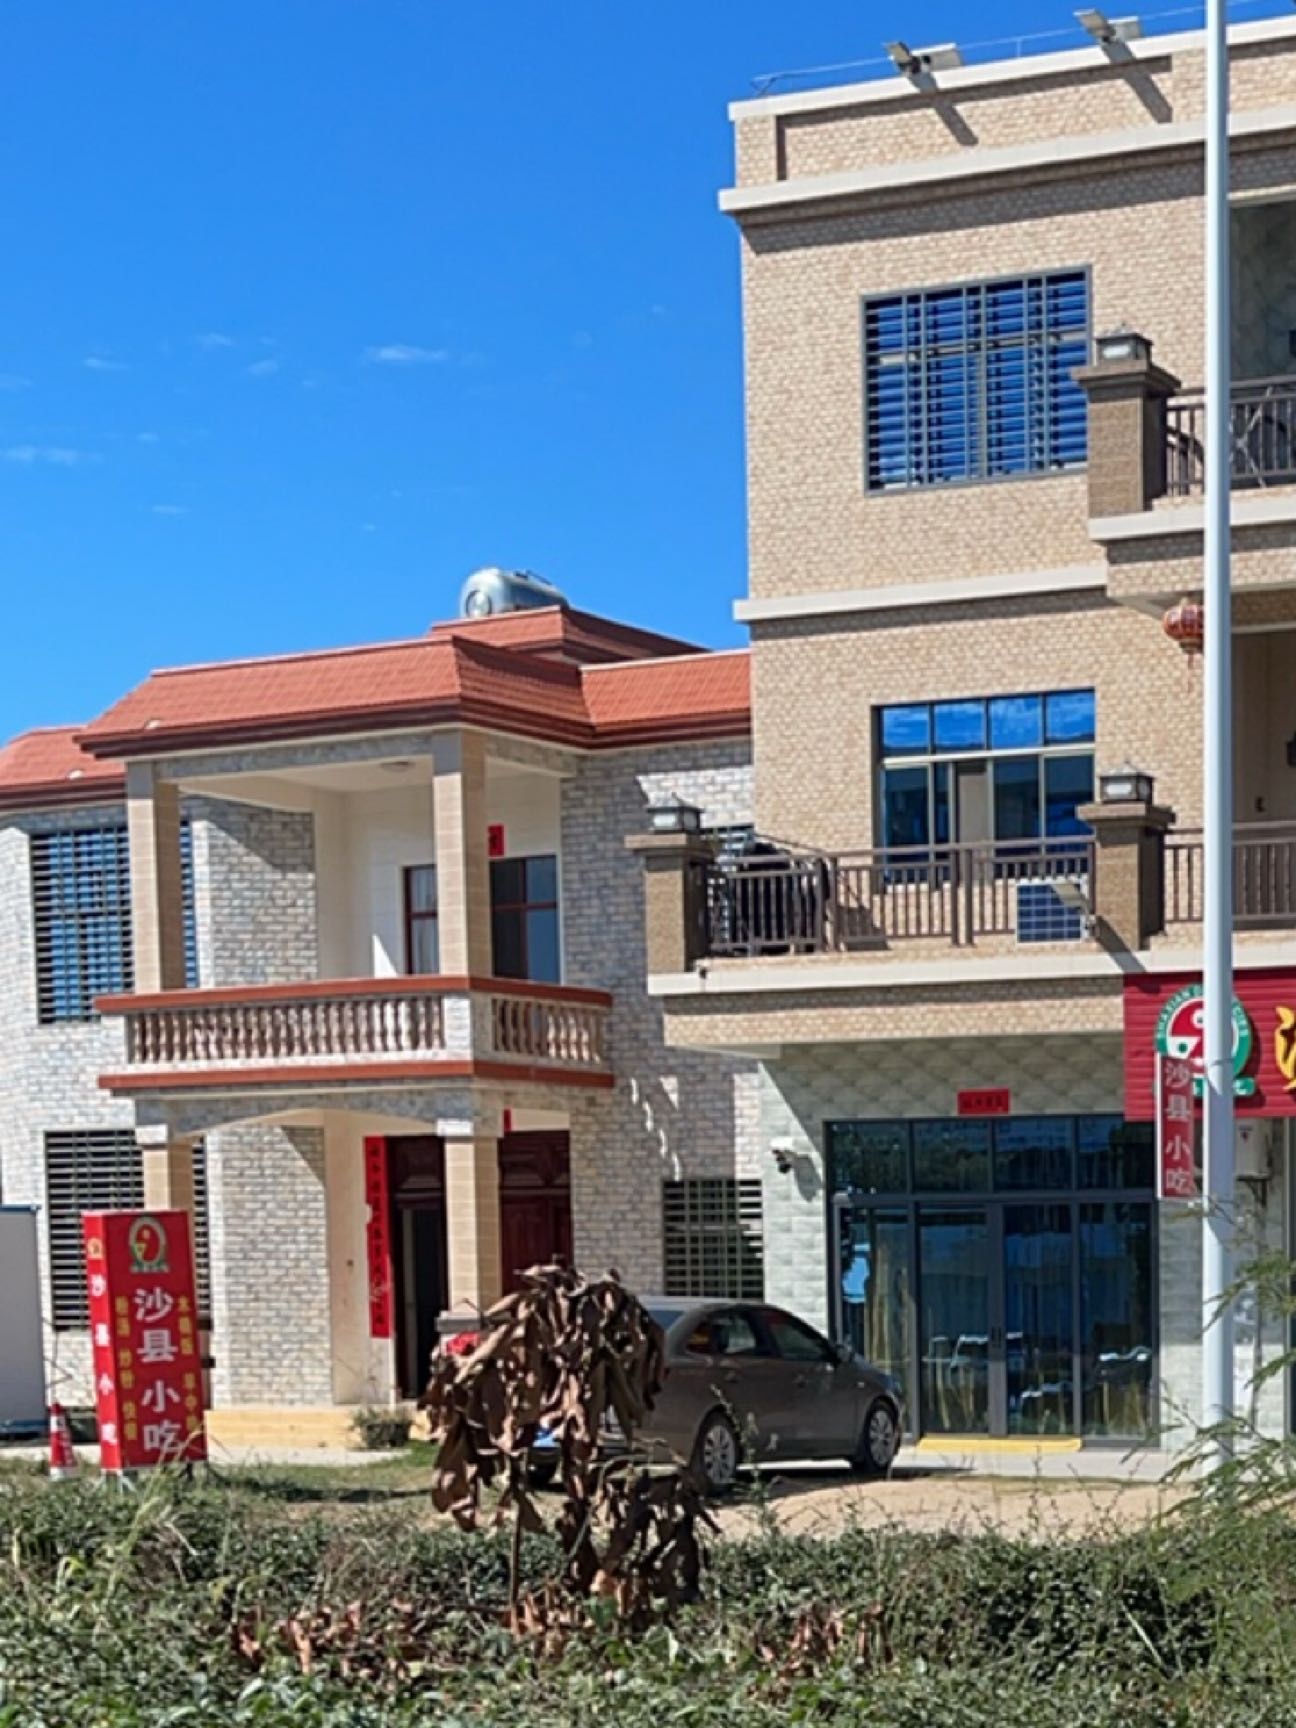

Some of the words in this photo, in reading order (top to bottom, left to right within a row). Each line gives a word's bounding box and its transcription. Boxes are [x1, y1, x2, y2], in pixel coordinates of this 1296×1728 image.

[1164, 1060, 1197, 1194] 沙县小吃
[134, 1286, 182, 1456] 沙县小吃
